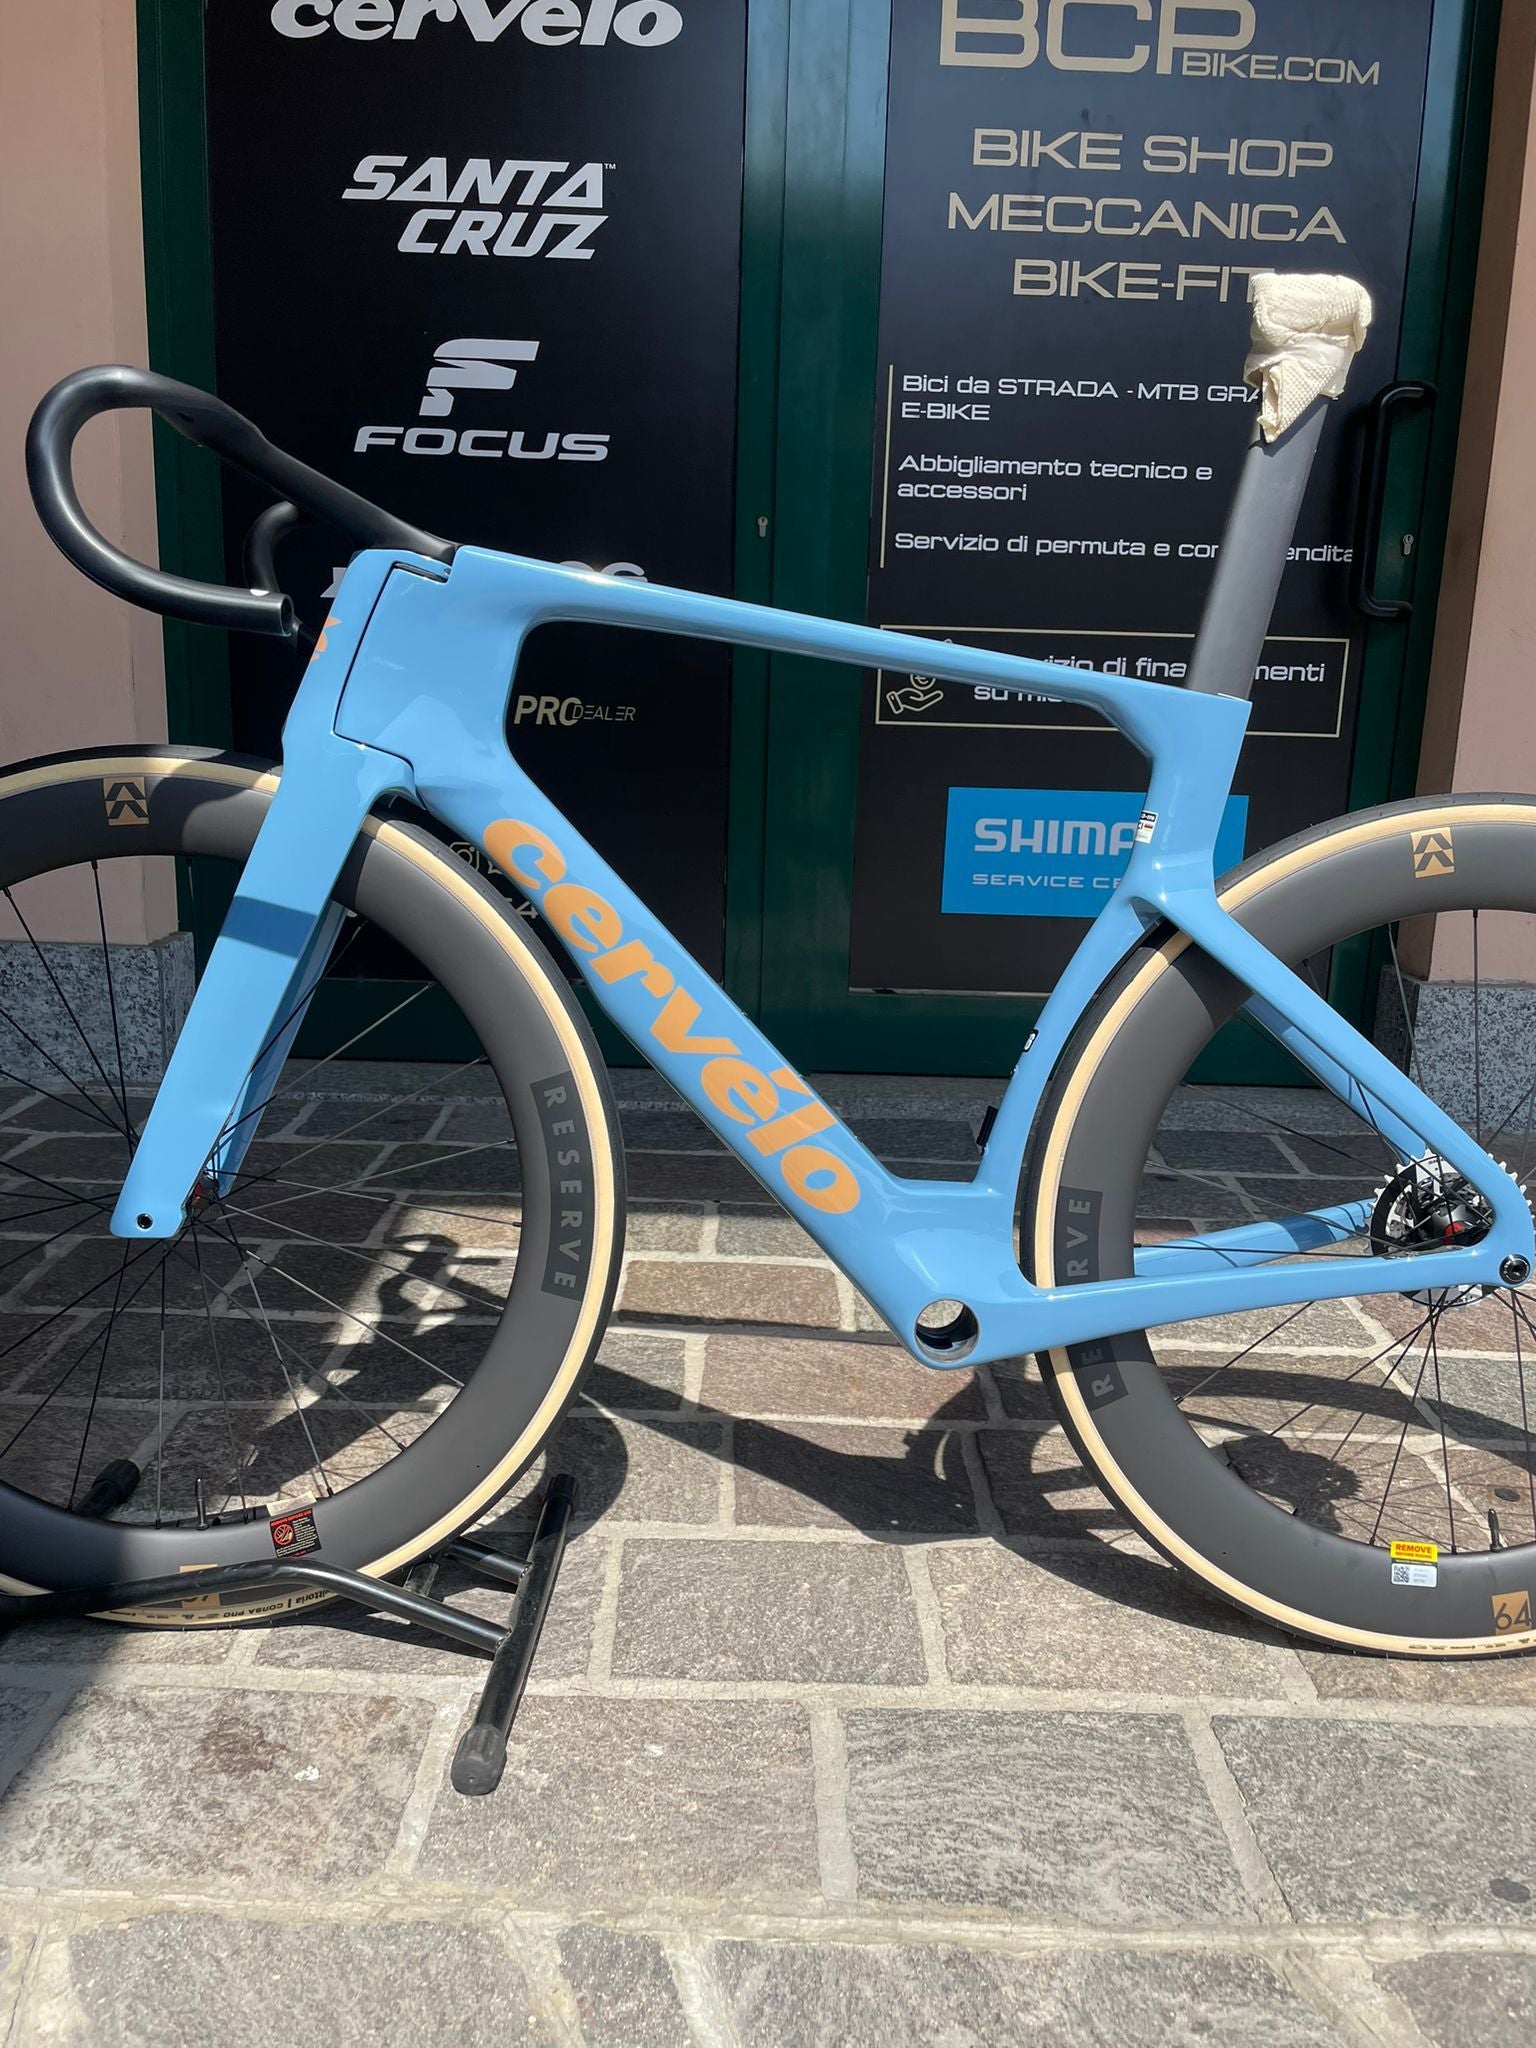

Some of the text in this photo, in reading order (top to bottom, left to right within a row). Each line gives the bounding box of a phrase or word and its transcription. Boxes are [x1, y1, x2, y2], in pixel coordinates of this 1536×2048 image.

[939, 0, 1380, 86] BCP BIKE.COM
[972, 128, 1334, 178] BIKE SHOP
[341, 155, 604, 208] SANTA
[397, 207, 609, 260] CRUZ
[948, 191, 1347, 244] MECCANICA
[1013, 258, 1276, 303] BIKE-FIT
[902, 374, 949, 394] Bici
[956, 375, 990, 395] da
[997, 378, 1119, 399] STRADA
[901, 401, 991, 422] E-BIKE
[353, 425, 611, 462] FOCUS
[898, 454, 1213, 481] Abbigliamento tecnico e
[897, 482, 1027, 502] accessori
[894, 532, 999, 553] Servizio
[1007, 534, 1029, 554] di
[1035, 537, 1146, 558] permuta
[1153, 543, 1171, 557] e
[513, 695, 637, 727] PRO DEALER
[974, 818, 1137, 856] SHIMA
[971, 873, 1084, 889] SERVICE
[484, 818, 860, 1214] cervélo
[543, 1085, 583, 1289] RESERVE
[1395, 1544, 1432, 1554] REMOVE
[1495, 1598, 1532, 1630] 64
